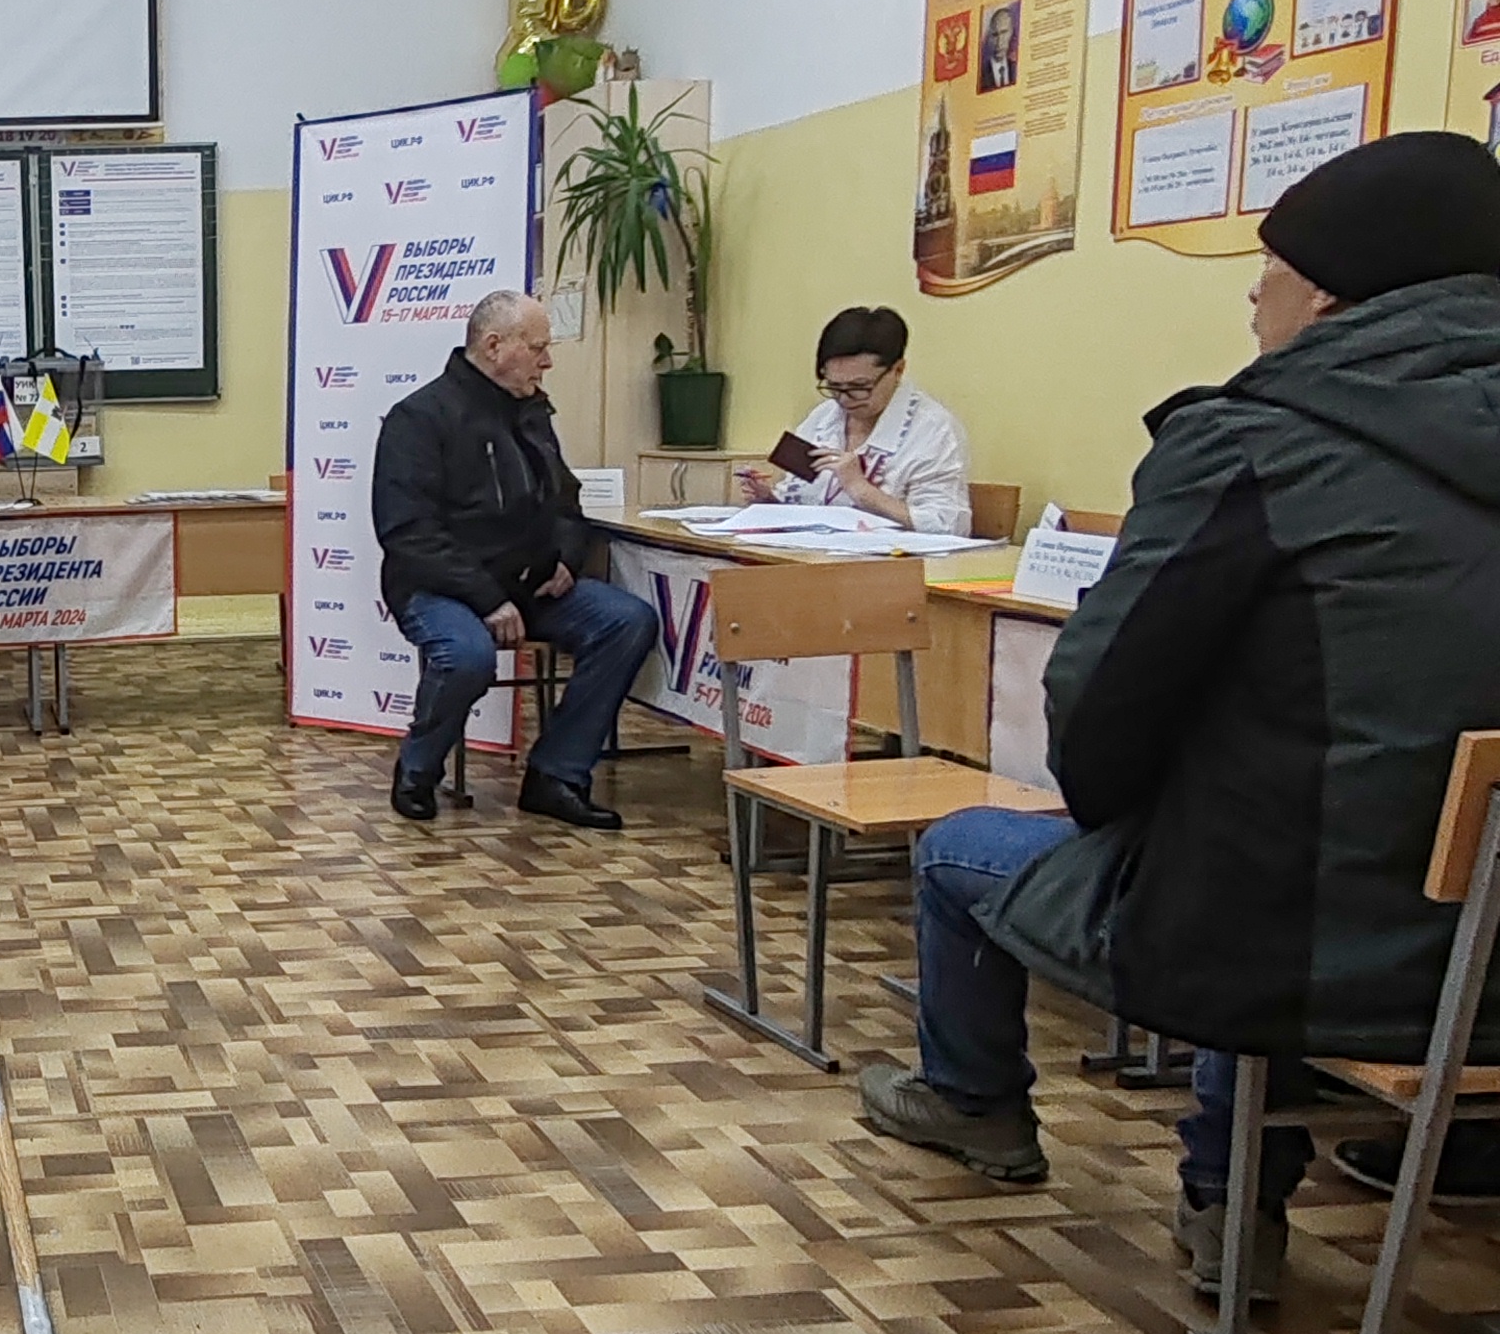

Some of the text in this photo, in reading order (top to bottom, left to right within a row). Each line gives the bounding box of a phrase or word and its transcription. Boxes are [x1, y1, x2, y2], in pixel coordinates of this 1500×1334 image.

[403, 236, 475, 258] ВЫБОРЫ
[394, 258, 496, 281] ПРЕЗИДЕНТА
[386, 284, 450, 303] РОССИИ
[411, 305, 449, 322] МАРТА
[451, 304, 474, 319] 202
[80, 442, 88, 453] 2
[0, 610, 49, 629] МАРТА
[51, 609, 87, 626] 2024
